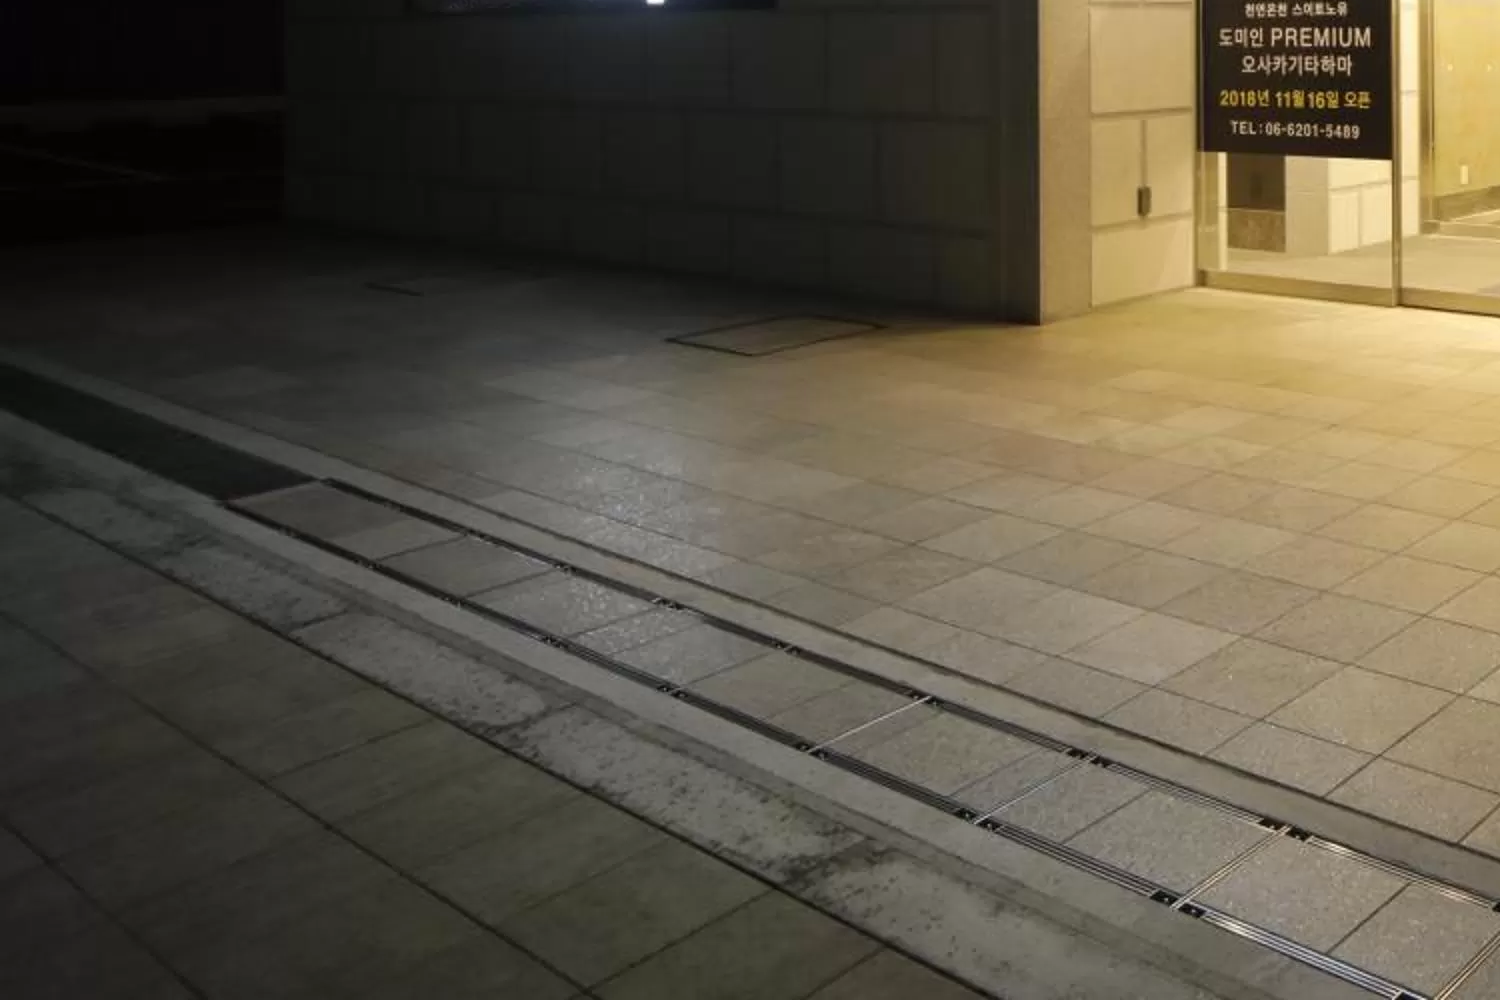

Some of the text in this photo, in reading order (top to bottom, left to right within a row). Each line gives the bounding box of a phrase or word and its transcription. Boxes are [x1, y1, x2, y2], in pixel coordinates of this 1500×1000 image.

[1219, 27, 1371, 48] 도미인 PREMIUM
[1241, 54, 1352, 76] 오사카기타하마
[1220, 89, 1270, 107] 2018년
[1344, 91, 1371, 109] 오픈
